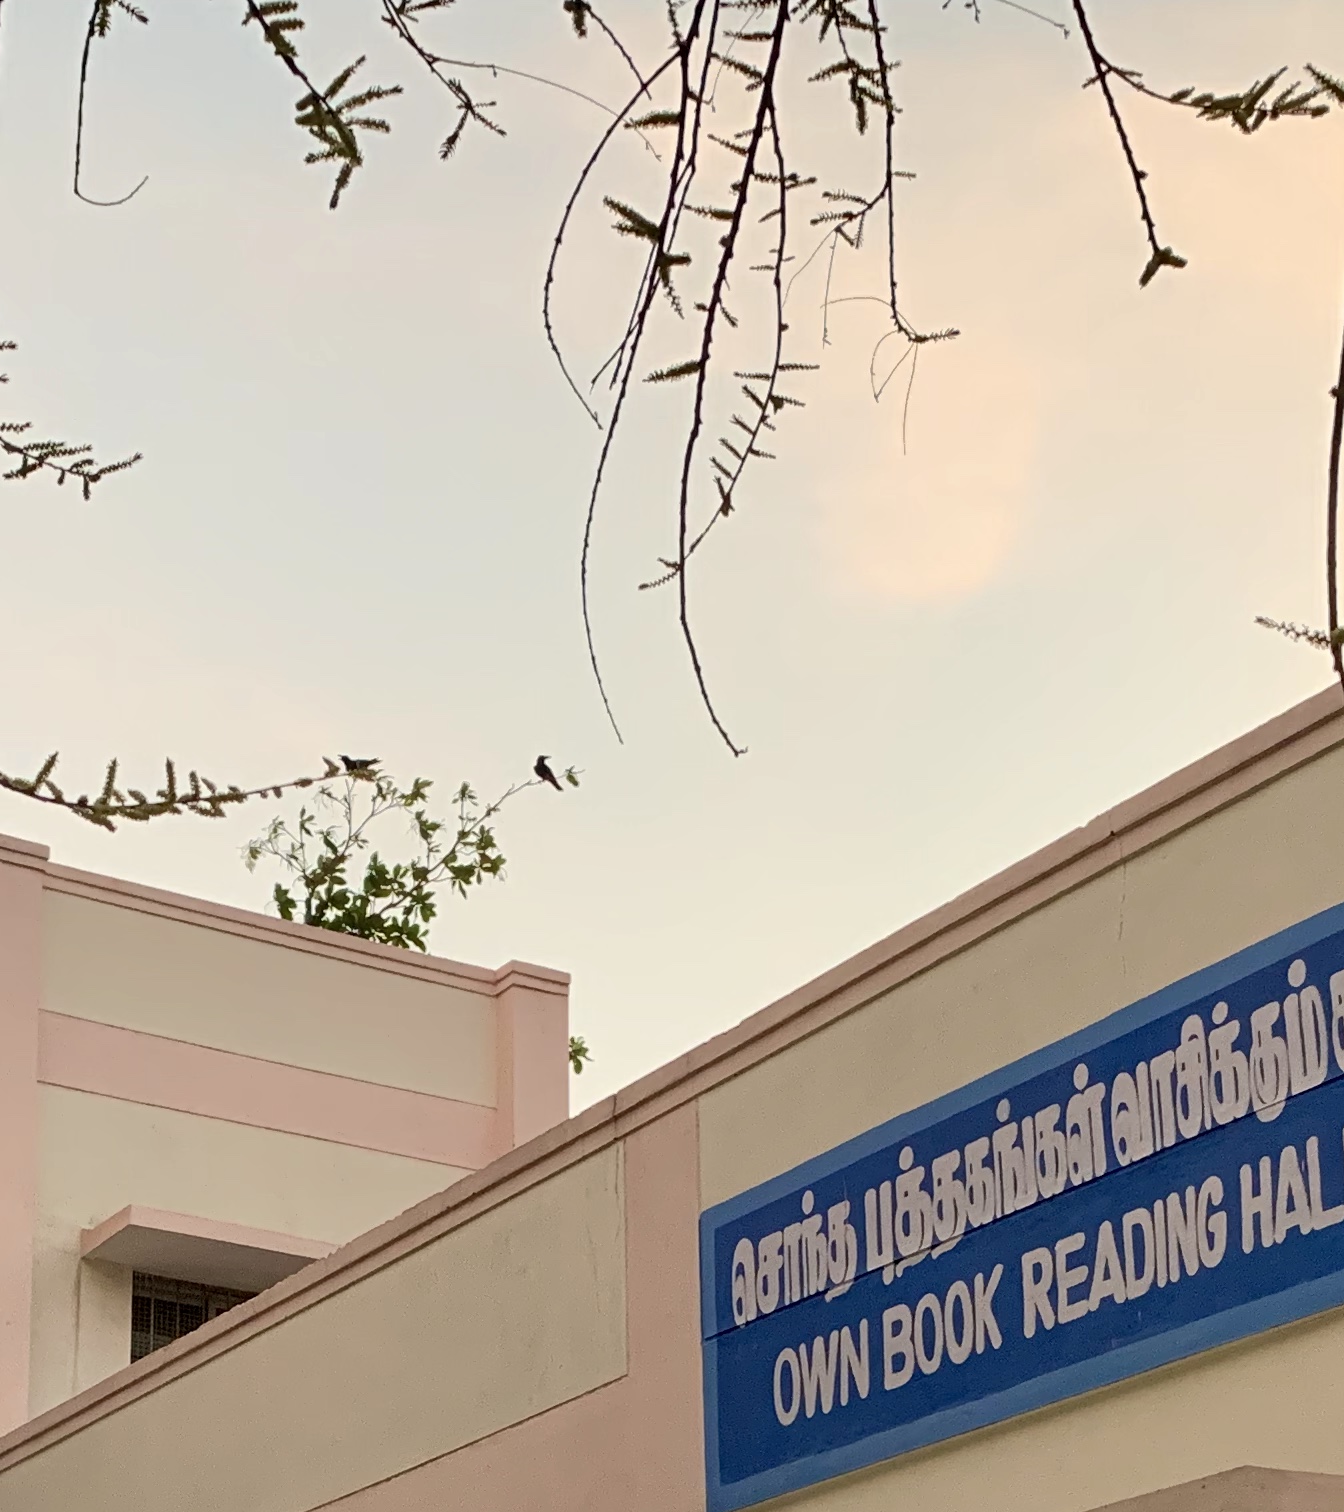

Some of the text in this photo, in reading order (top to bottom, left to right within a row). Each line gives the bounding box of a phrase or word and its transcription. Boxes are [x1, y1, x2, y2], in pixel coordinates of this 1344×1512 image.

[864, 1063, 1107, 1285] புத்தகங்கள்
[1111, 959, 1328, 1167] வாசிக்கும்
[773, 1319, 870, 1426] OWN
[883, 1264, 1004, 1391] BOOK
[1022, 1176, 1227, 1339] READING
